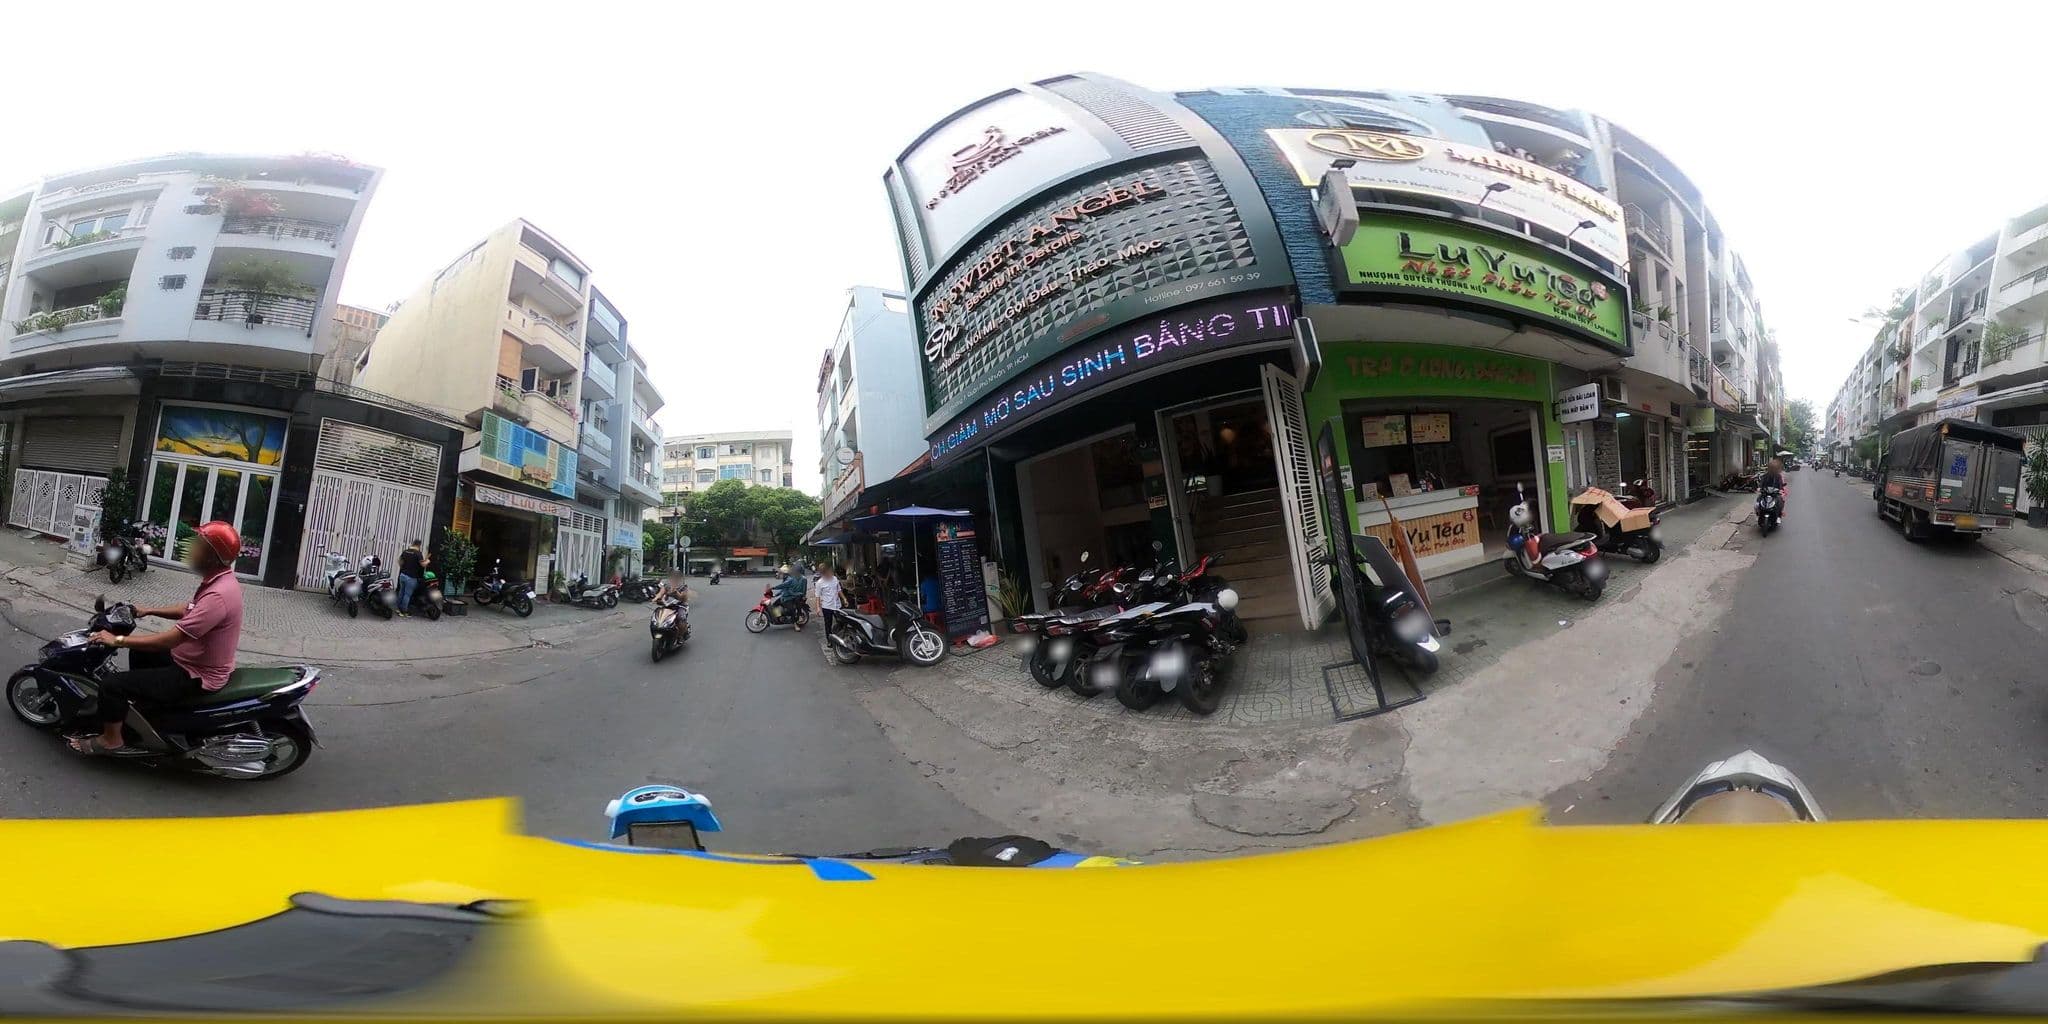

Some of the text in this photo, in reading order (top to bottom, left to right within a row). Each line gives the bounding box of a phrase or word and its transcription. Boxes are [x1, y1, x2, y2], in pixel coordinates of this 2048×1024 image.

[948, 237, 1019, 306] SWEET
[1026, 180, 1167, 244] ANGEL
[965, 268, 1007, 313] Beauty
[1022, 229, 1084, 268] Details
[1144, 271, 1262, 306] Hotline: 097 661 59 39
[1359, 271, 1401, 281] NHƯỢNG
[925, 322, 961, 363] Spa
[1013, 375, 1055, 411] SAU
[1061, 344, 1126, 388] SINH
[1133, 312, 1236, 361] BẰNG
